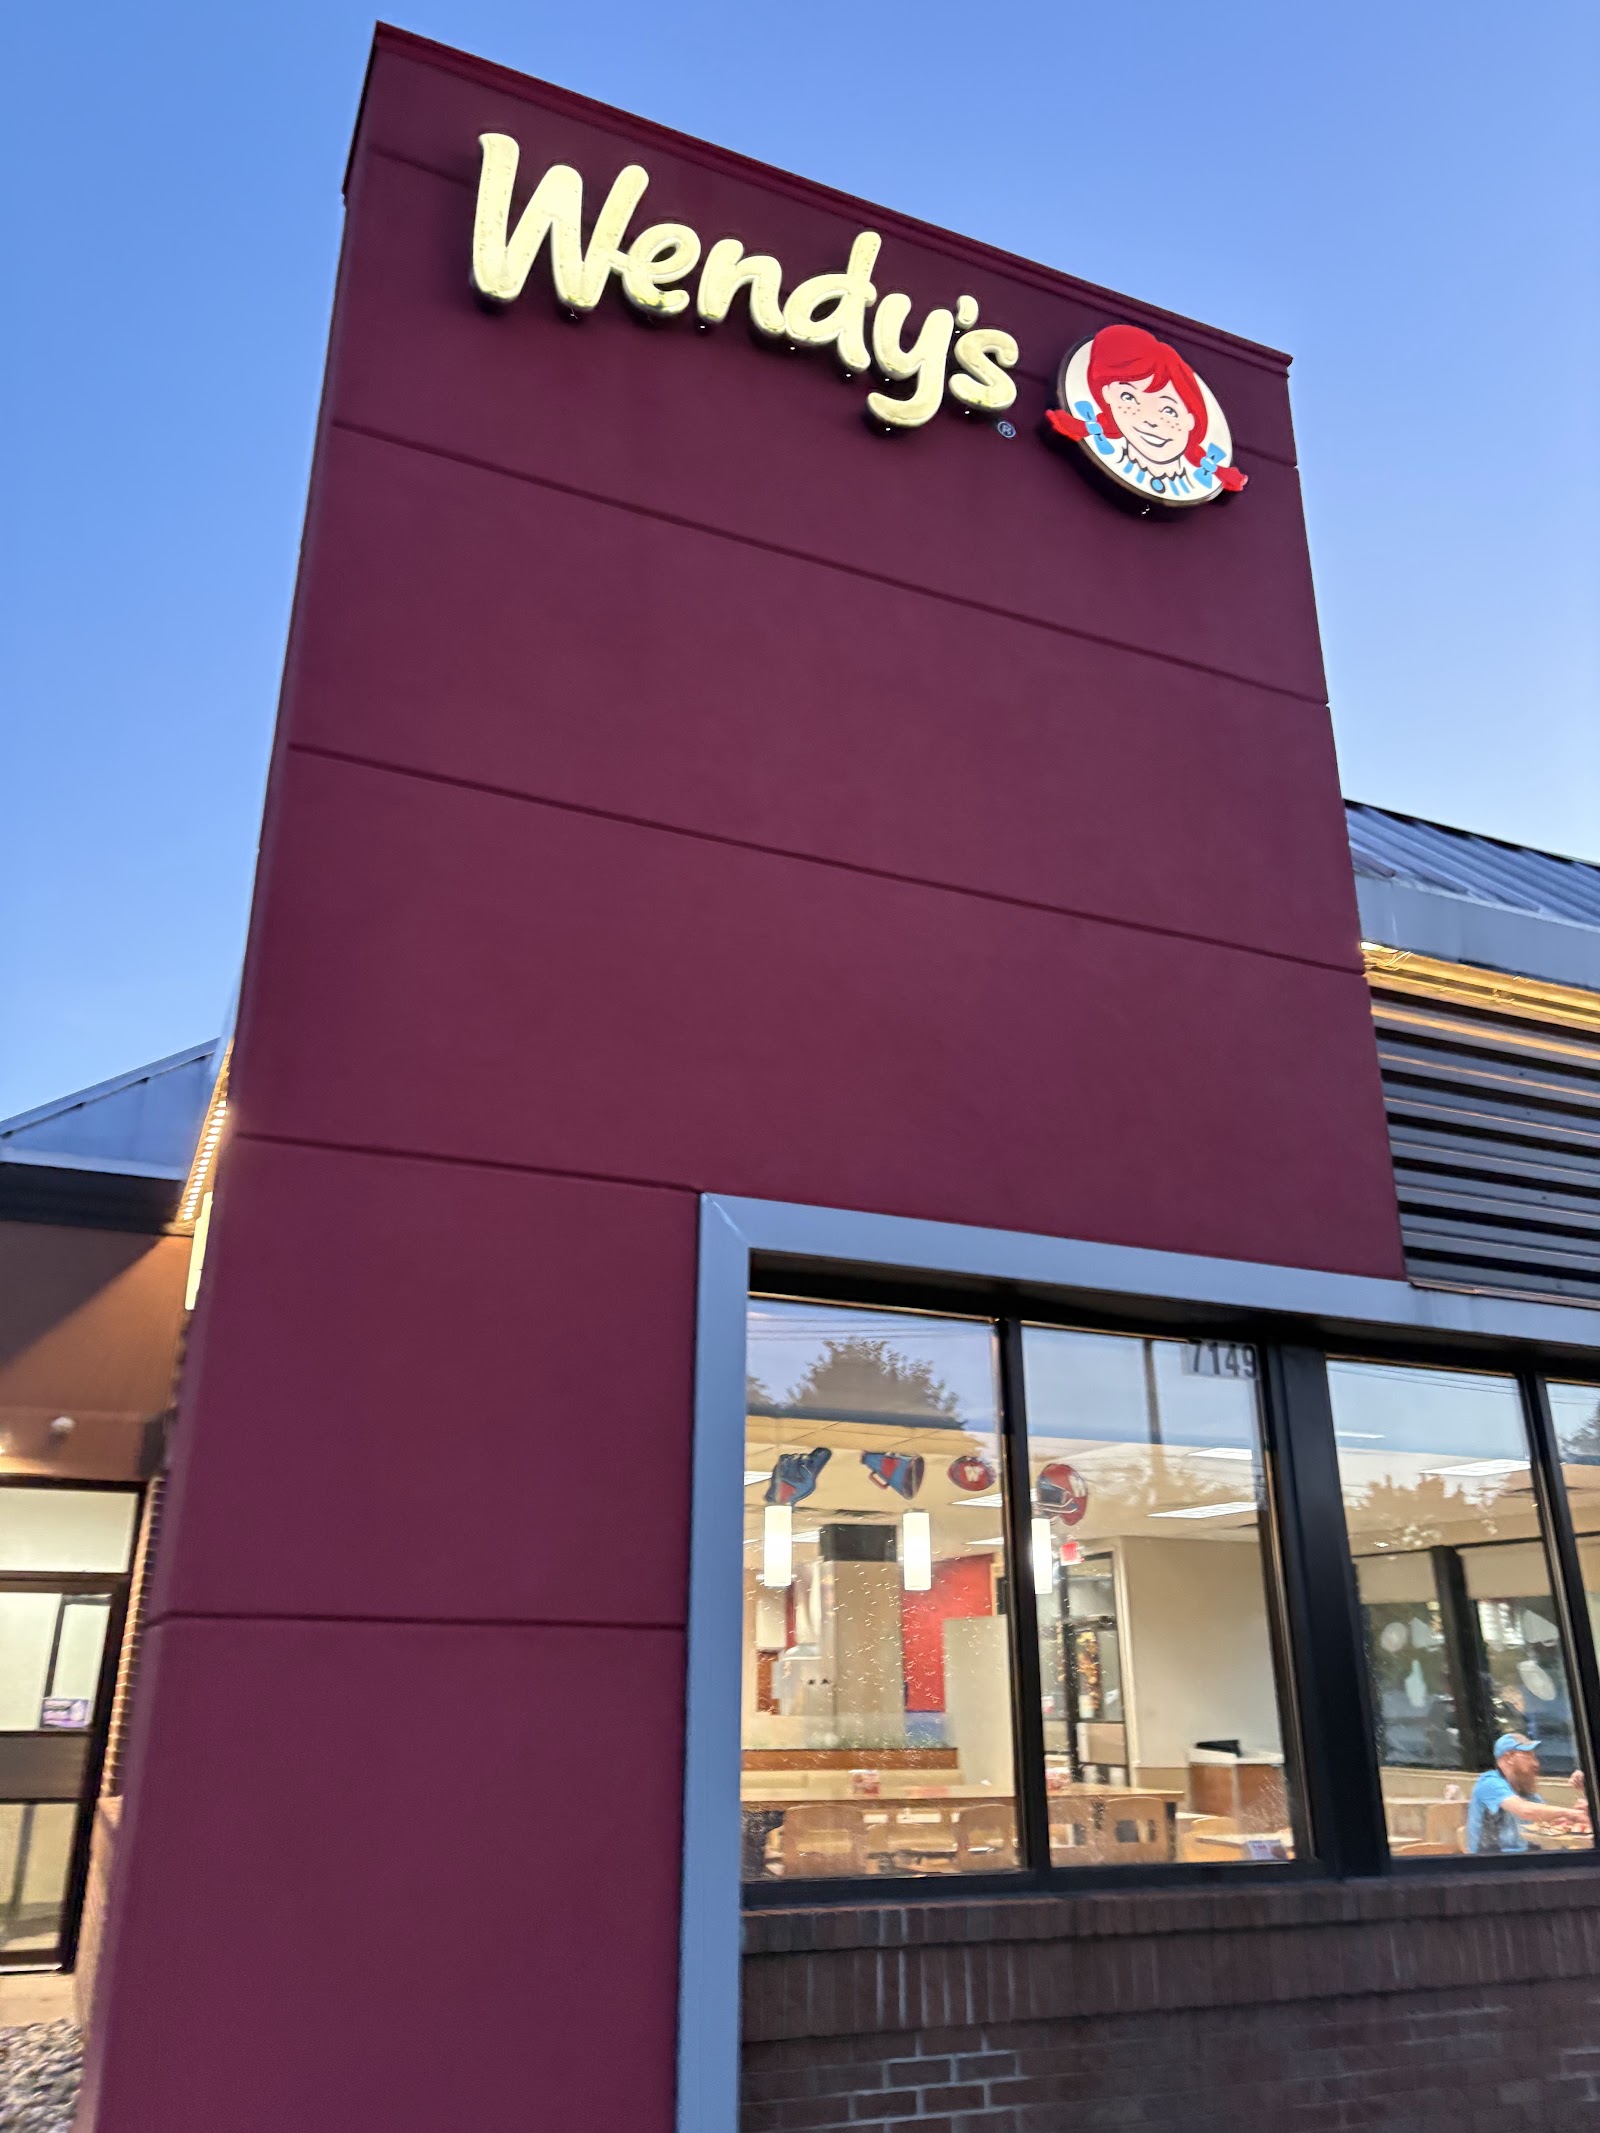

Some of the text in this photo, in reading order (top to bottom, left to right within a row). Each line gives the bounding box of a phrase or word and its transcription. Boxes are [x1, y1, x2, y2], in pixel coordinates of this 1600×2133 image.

[472, 132, 1019, 427] Wendy's
[1187, 1340, 1257, 1379] 7149
[964, 1465, 985, 1482] W
